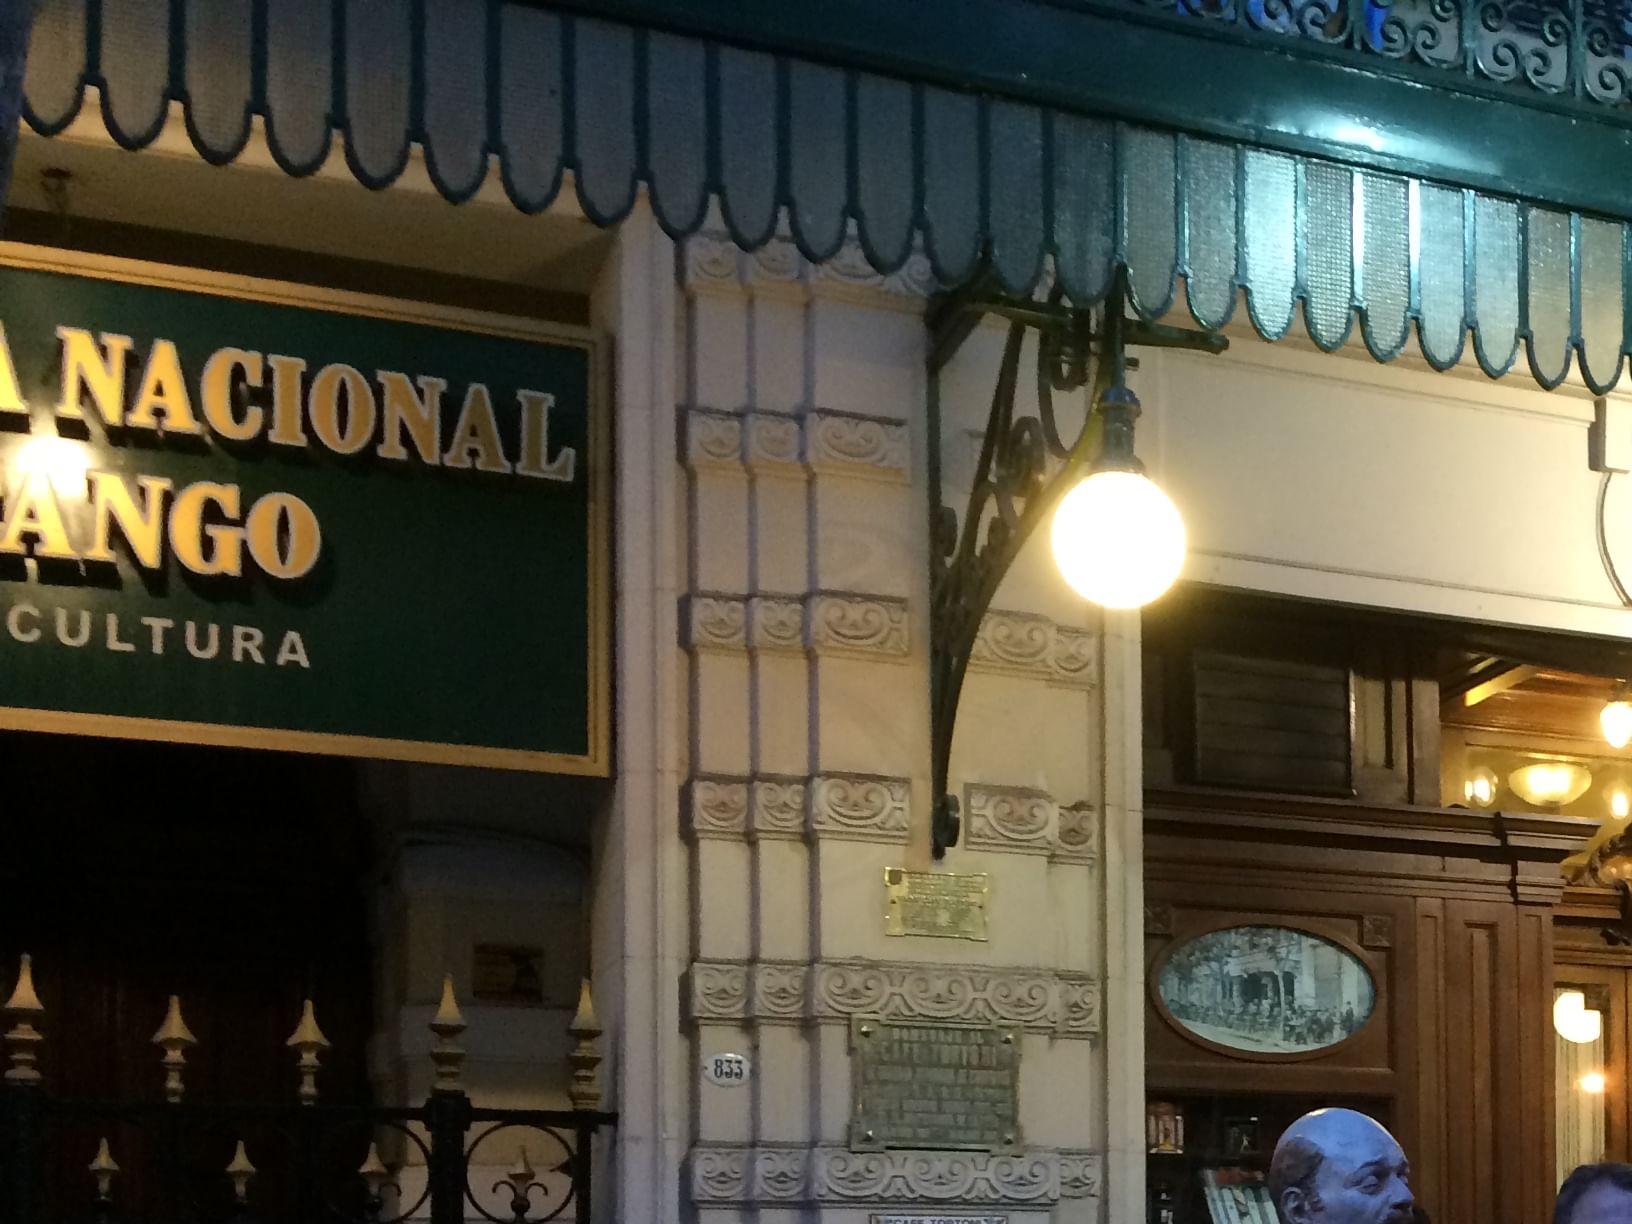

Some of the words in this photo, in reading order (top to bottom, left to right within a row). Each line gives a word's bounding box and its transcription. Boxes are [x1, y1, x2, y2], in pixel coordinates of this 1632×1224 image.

[55, 324, 576, 483] NACIONAL
[0, 468, 321, 580] ANGO
[6, 603, 311, 668] CULTURA
[714, 1059, 743, 1080] 833
